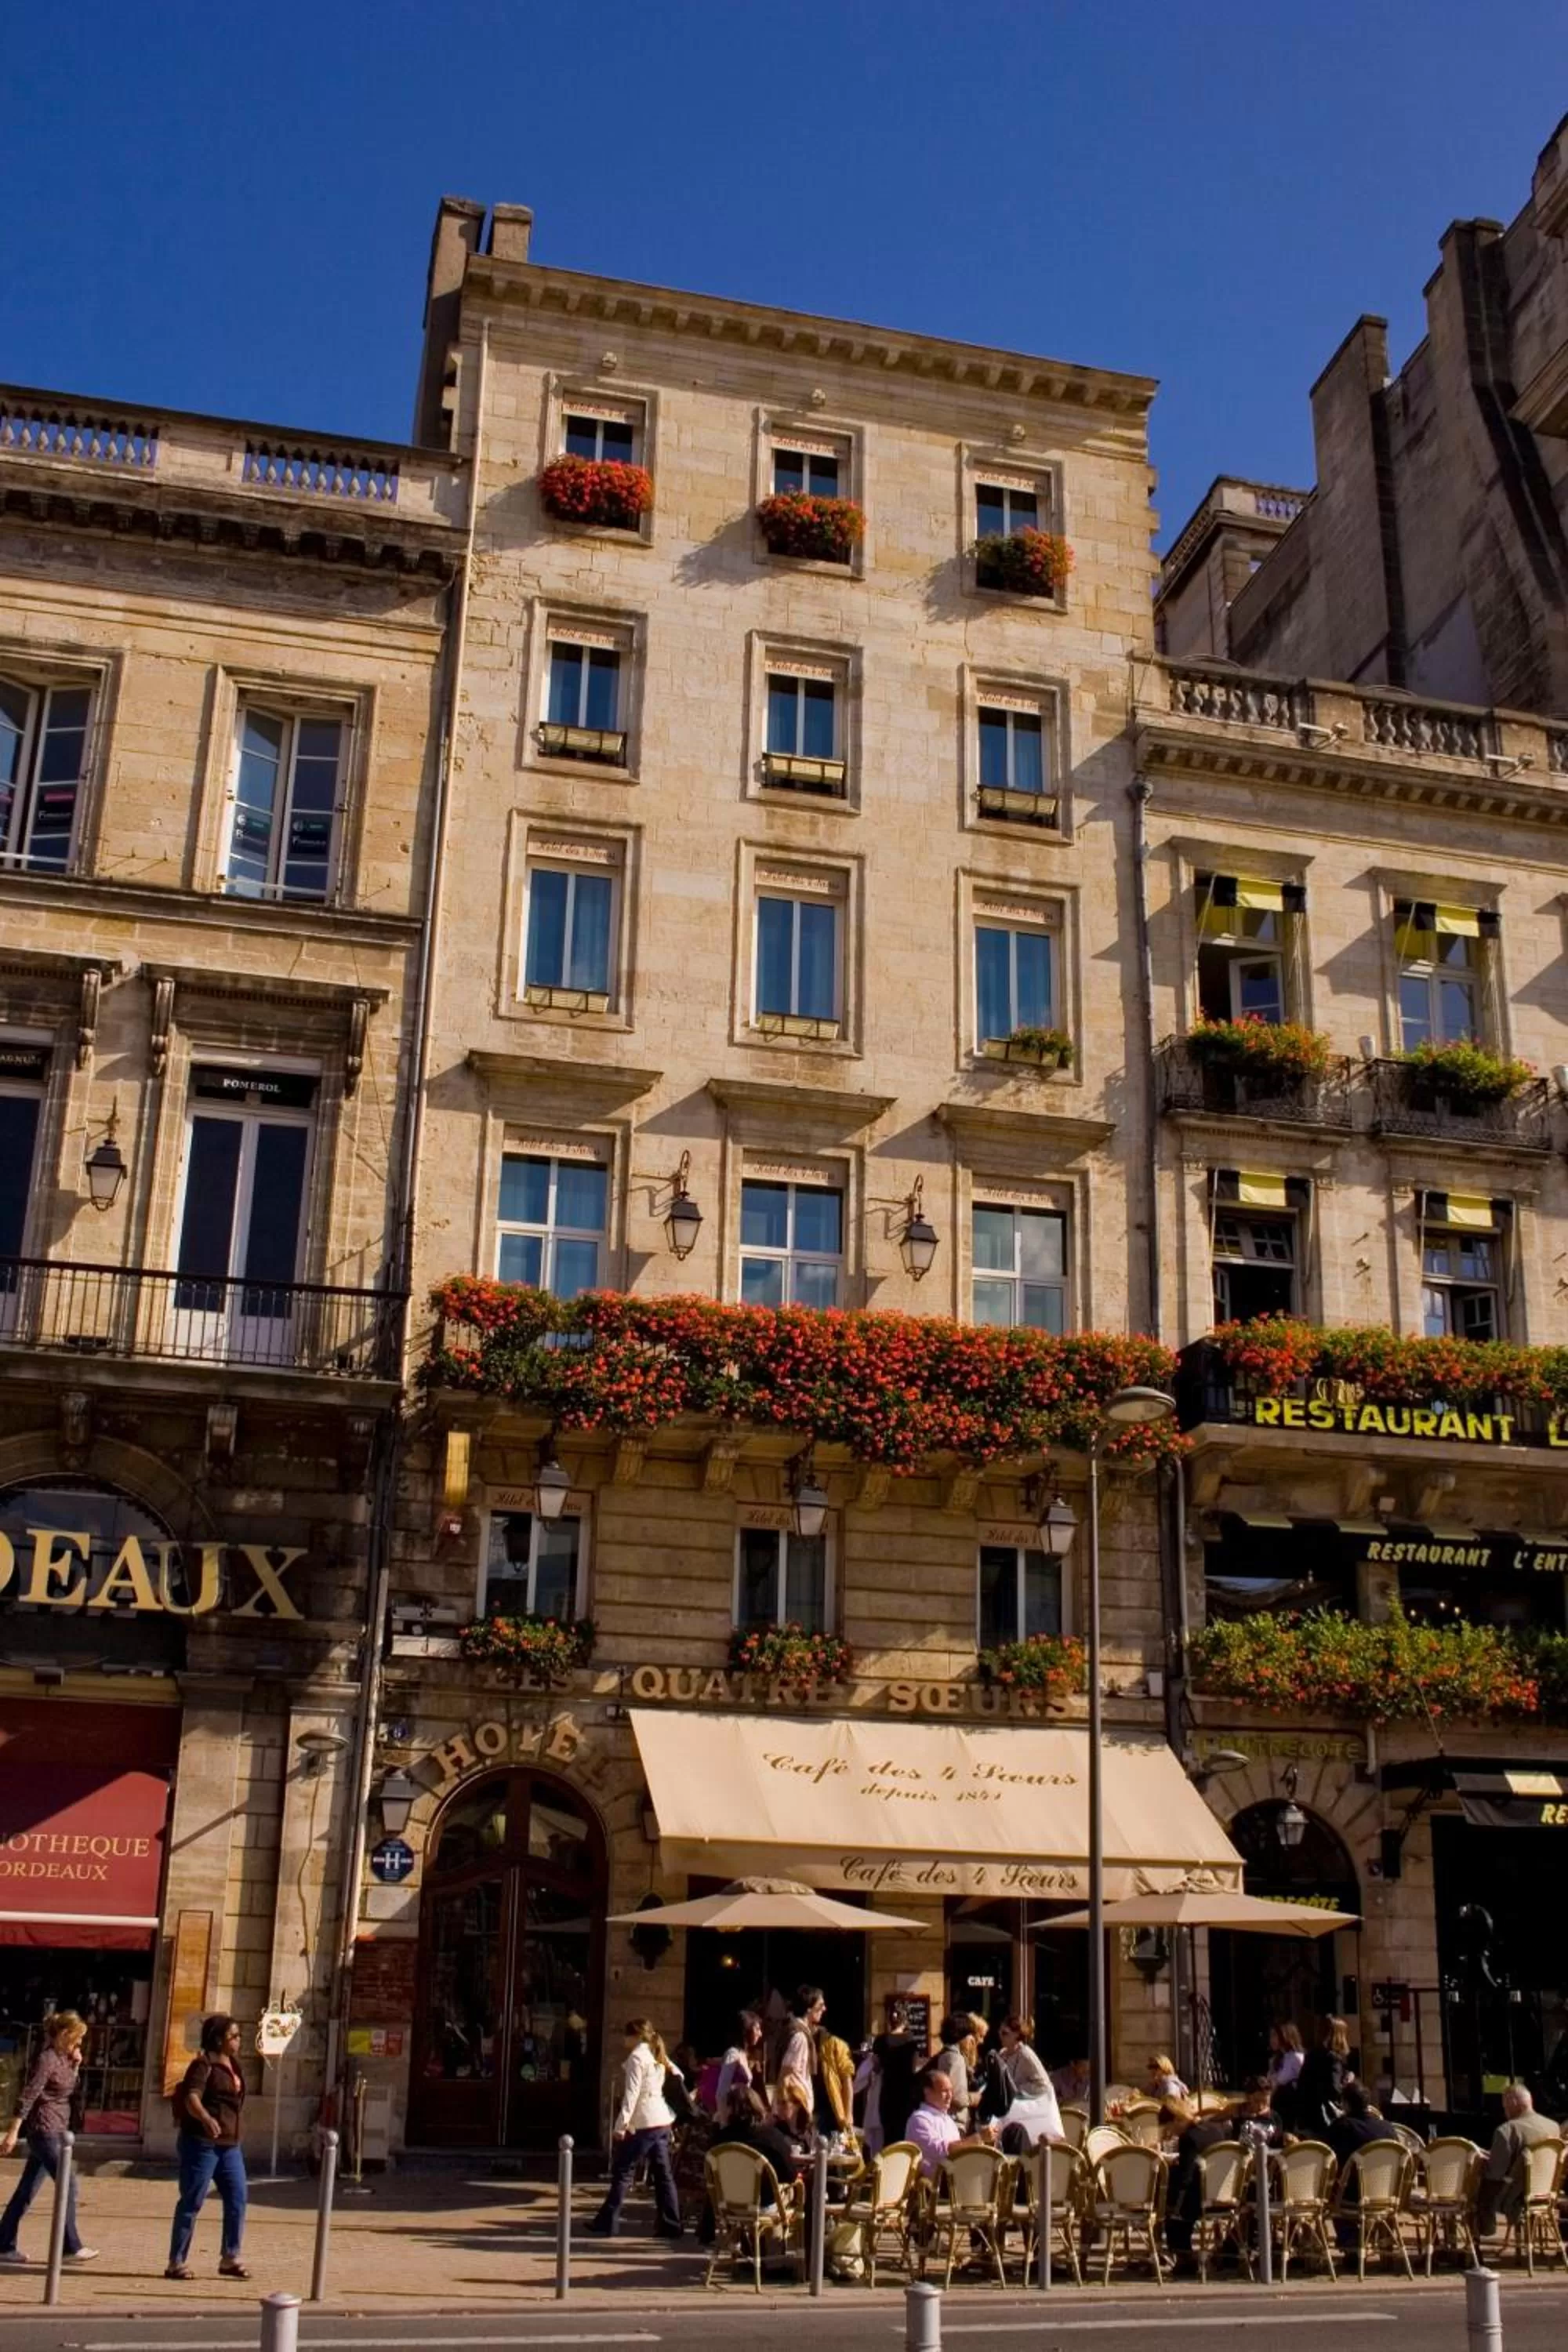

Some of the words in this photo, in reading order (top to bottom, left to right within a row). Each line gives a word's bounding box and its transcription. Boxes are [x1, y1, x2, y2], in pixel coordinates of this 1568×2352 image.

[223, 1078, 281, 1094] POMEROL
[1255, 1396, 1515, 1443] RESTAURANT
[1367, 1541, 1490, 1566] RESTAURANT
[0, 1527, 308, 1620] EAUX
[763, 1753, 849, 1784] Café
[869, 1761, 921, 1780] des
[861, 1782, 937, 1801] depuis
[385, 1851, 400, 1871] H
[840, 1856, 902, 1889] Café
[916, 1860, 957, 1884] des
